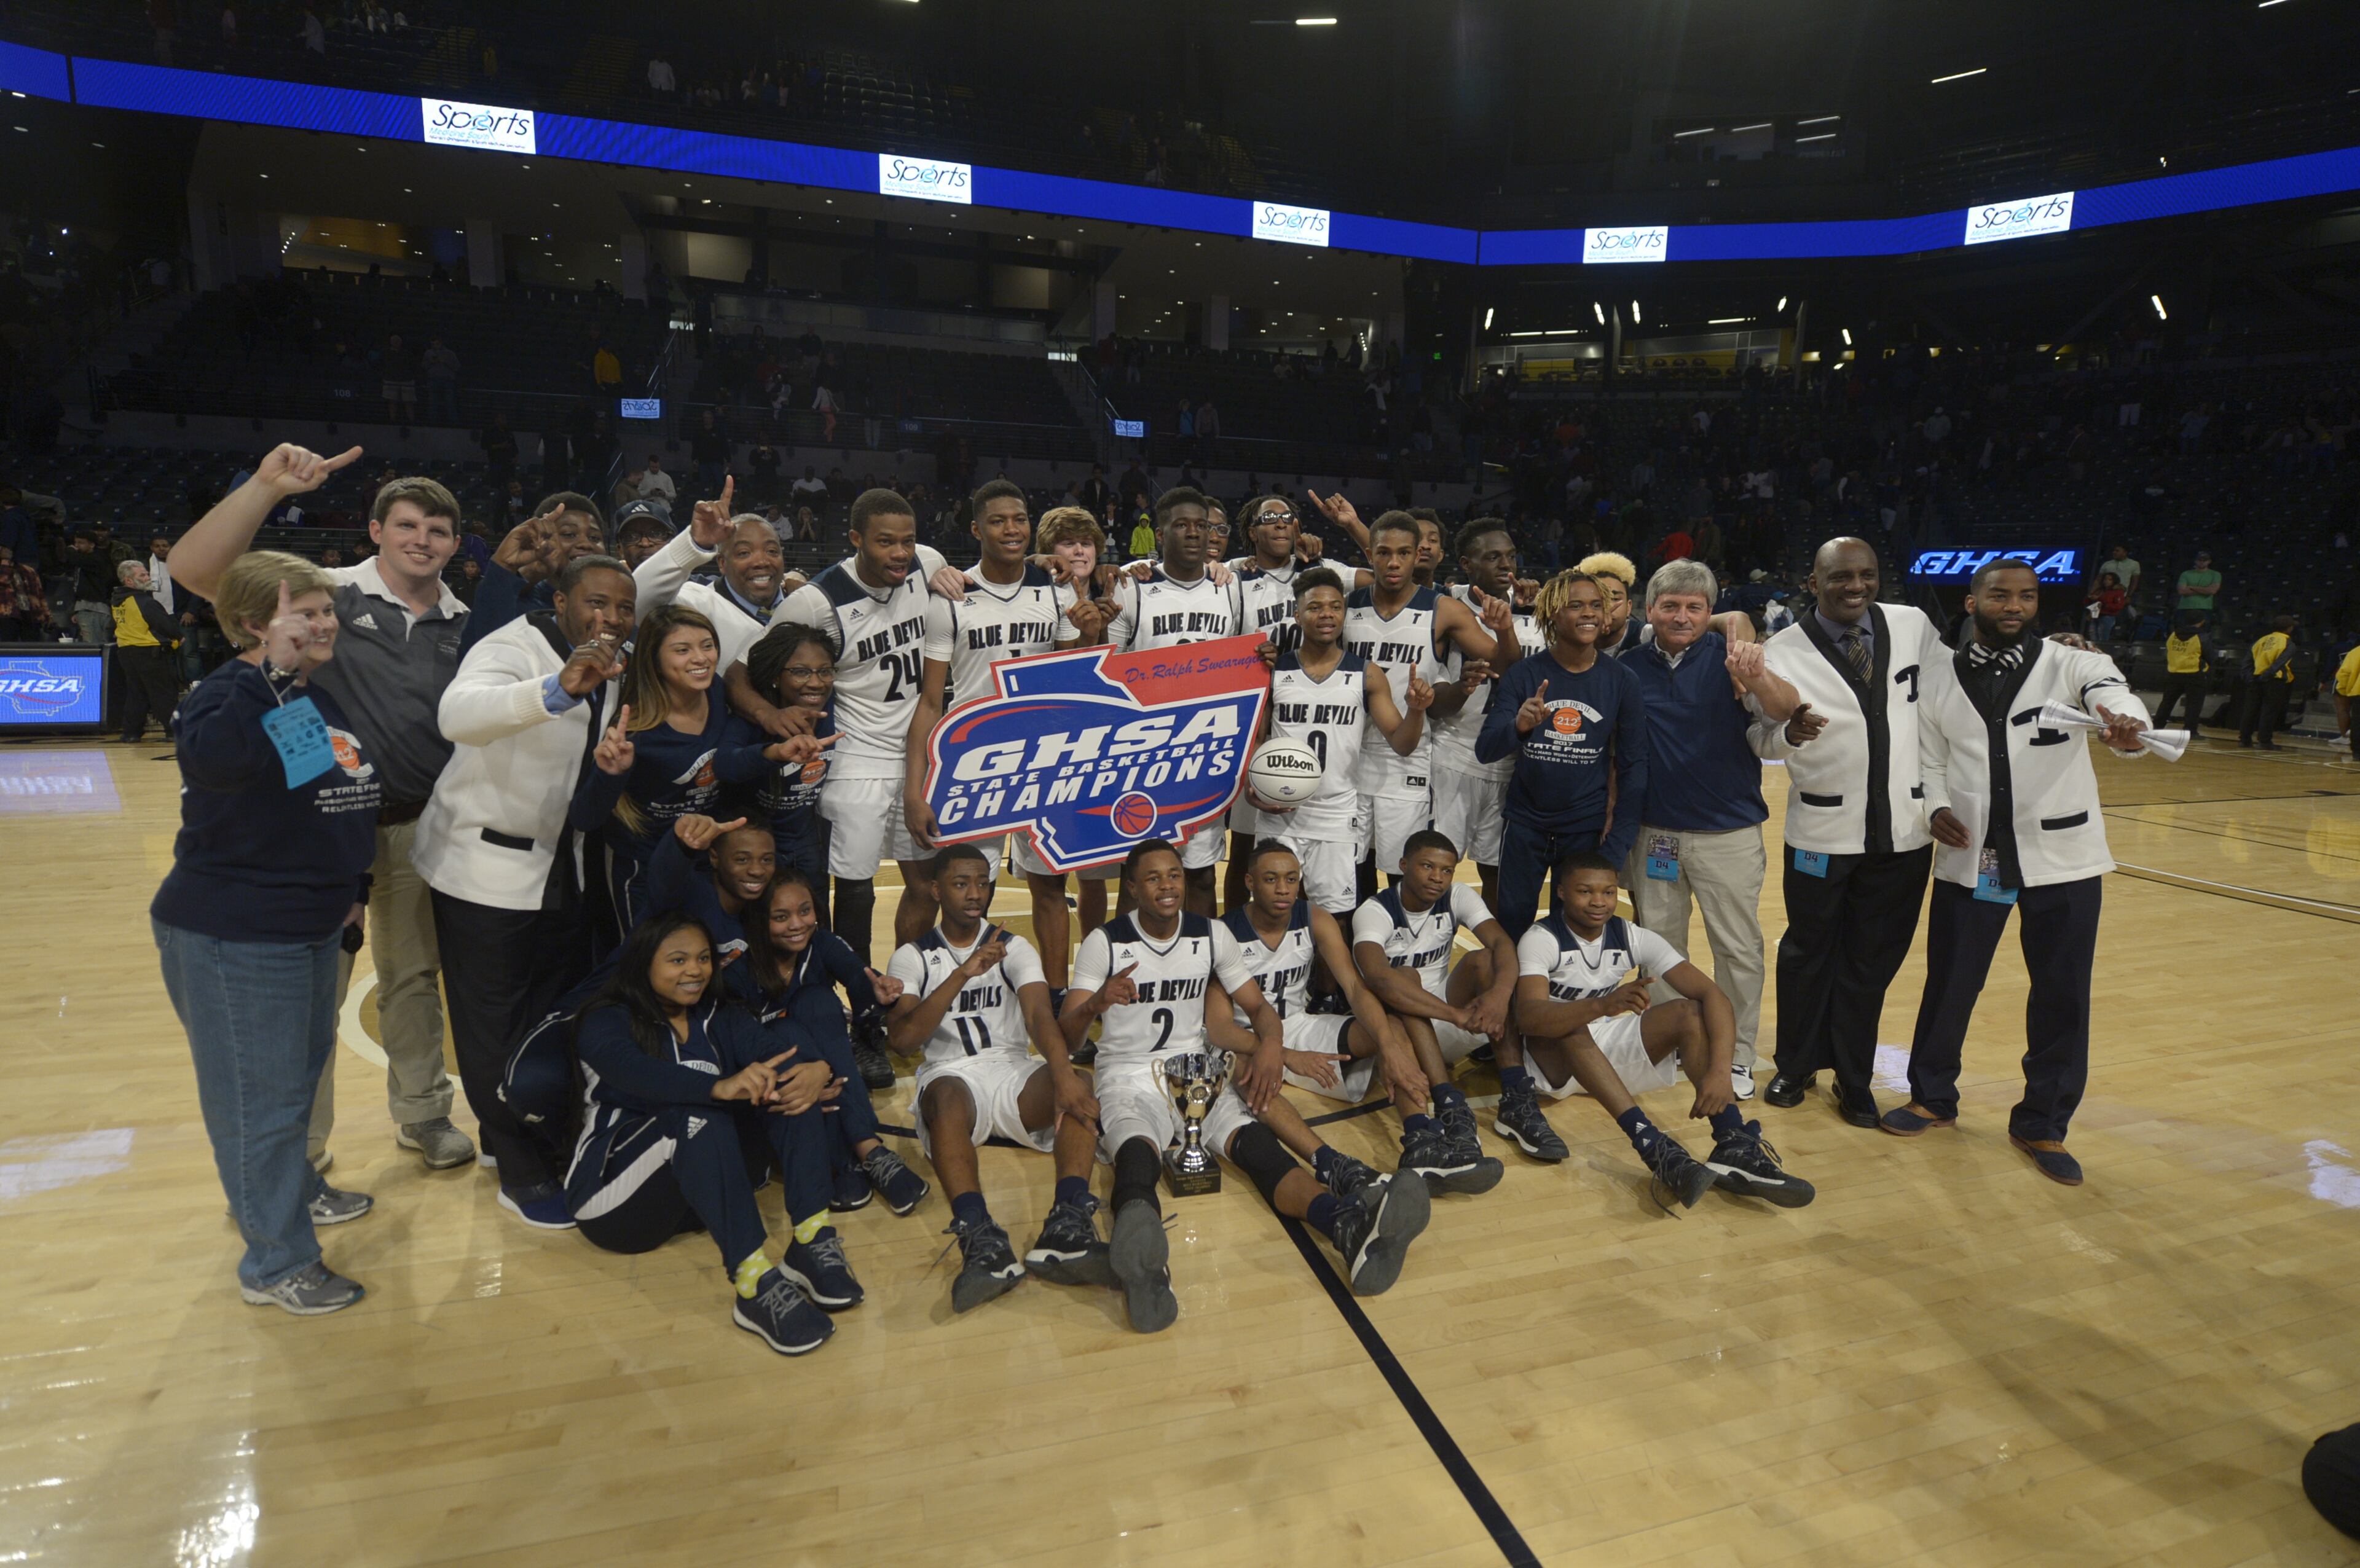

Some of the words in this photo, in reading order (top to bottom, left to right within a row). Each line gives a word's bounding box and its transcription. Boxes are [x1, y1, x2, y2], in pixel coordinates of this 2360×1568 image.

[433, 104, 530, 135] Sports
[887, 159, 967, 187] Sports
[1260, 206, 1326, 231] Sports
[1975, 197, 2069, 228] Sports
[1591, 230, 1664, 250] Sports
[334, 389, 351, 398] 108
[907, 578, 914, 594] T
[1034, 589, 1041, 602] T
[1152, 613, 1184, 636] BLUE
[1187, 613, 1227, 635] DEVILS
[1257, 603, 1284, 627] BLUE
[1412, 613, 1421, 624] T
[1523, 617, 1529, 627] T
[857, 630, 891, 662] BLUE
[892, 616, 926, 647] DEVIL
[968, 624, 1002, 649] BLUE
[1008, 622, 1053, 644] DEVILS
[1348, 641, 1373, 661] BLUE
[1377, 642, 1425, 664] DEVILS
[879, 648, 922, 702] 24
[1125, 668, 1149, 683] Dr.
[1152, 659, 1192, 678] Ralph
[1345, 673, 1352, 684] T
[1279, 704, 1309, 723] BLUE
[1312, 704, 1357, 725] DEVILS
[1570, 701, 1591, 715] DEVIL
[953, 705, 1240, 781] GHSA
[1527, 742, 1562, 751] TATE
[1546, 731, 1584, 741] BASKETBALL
[1267, 755, 1314, 772] Wilson
[1308, 731, 1327, 774] 0
[948, 772, 1040, 797] STATE
[1058, 738, 1233, 778] BASKETBALL
[318, 785, 364, 798] STATE
[938, 750, 1235, 825] CHAMPIONS
[1656, 860, 1669, 869] D4
[1804, 852, 1818, 862] D4
[1436, 916, 1442, 929] T
[1192, 941, 1200, 954] T
[1294, 932, 1302, 946] T
[1613, 952, 1621, 965] T
[1272, 962, 1307, 994] DEVIL
[959, 986, 1002, 1013] DEVILS
[1130, 981, 1156, 1004] UE
[1158, 977, 1205, 1001] DEVILS
[952, 1016, 992, 1056] 11
[1149, 1008, 1174, 1053] 2
